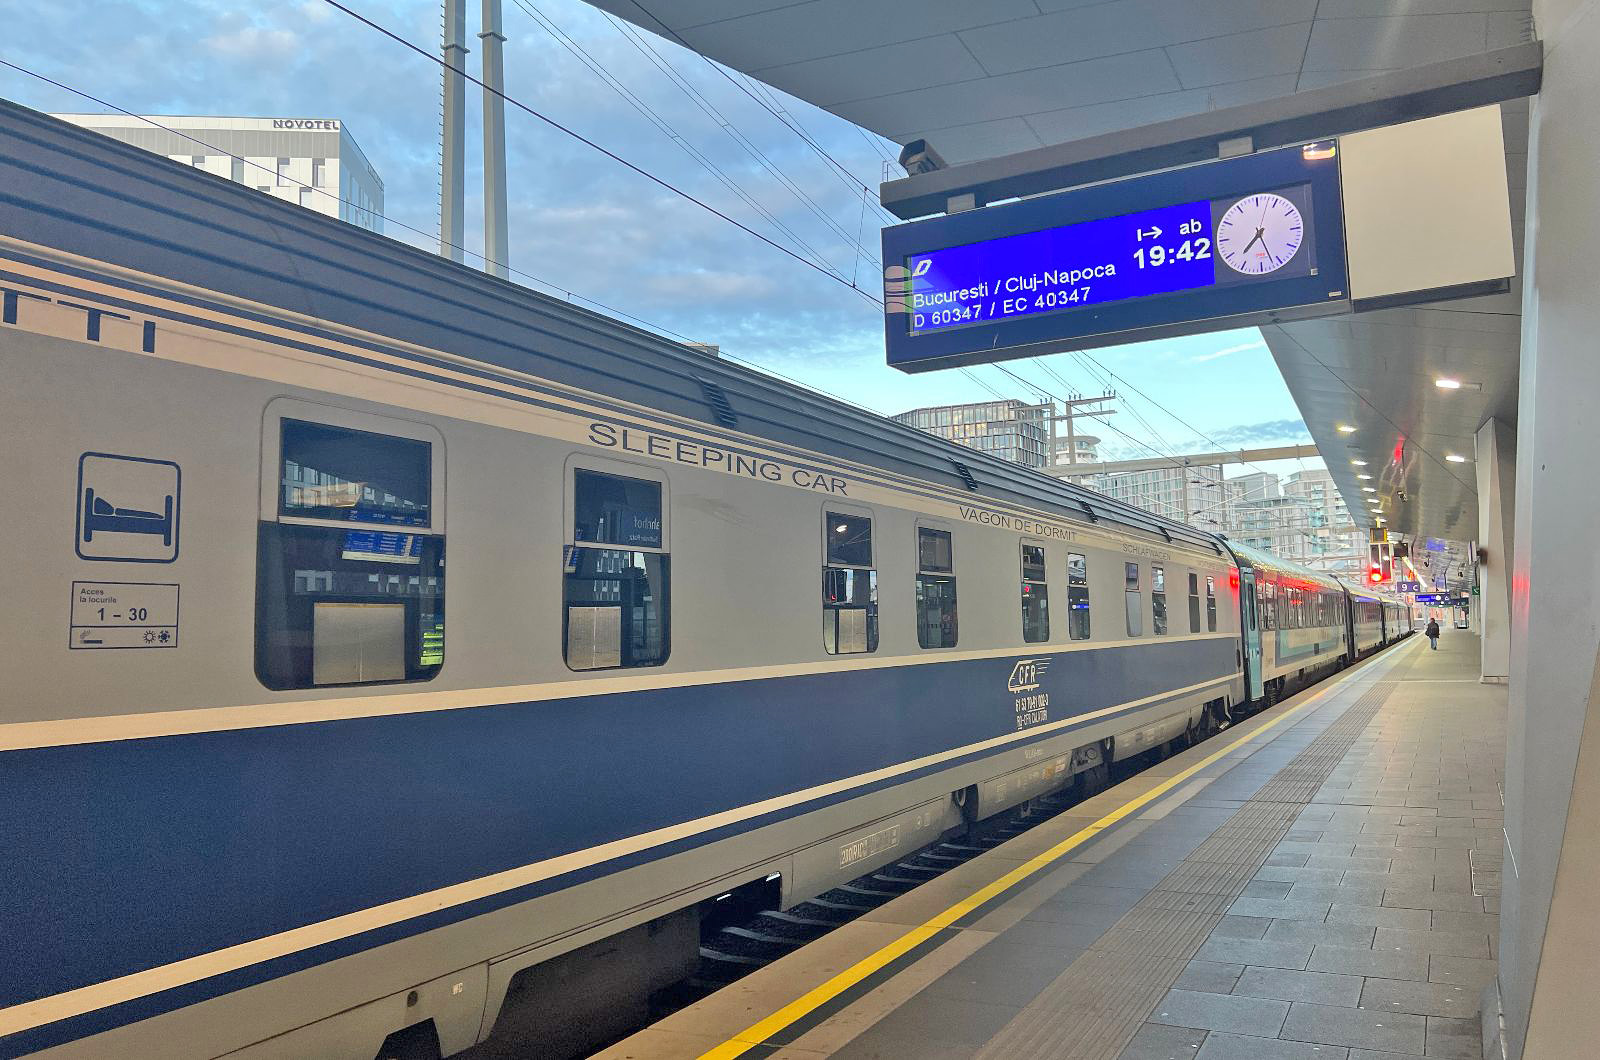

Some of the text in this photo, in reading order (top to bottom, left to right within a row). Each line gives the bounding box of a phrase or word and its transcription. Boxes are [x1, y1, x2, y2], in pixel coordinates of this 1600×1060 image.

[273, 119, 340, 130] NOVOTEL
[1179, 218, 1202, 235] ab
[1133, 237, 1211, 269] 19:42
[1005, 263, 1116, 293] Cluj-Napoca
[914, 314, 925, 328] D
[932, 304, 982, 325] 60347
[1003, 298, 1028, 314] EC
[1034, 286, 1091, 309] 40347
[588, 422, 849, 497] SLEEPING CAR
[959, 506, 1077, 541] VAGON DE DORMIT
[80, 588, 104, 596] Acces
[88, 596, 117, 604] locurile
[97, 607, 105, 621] 1
[128, 607, 148, 621] 30
[1019, 665, 1036, 684] CFR
